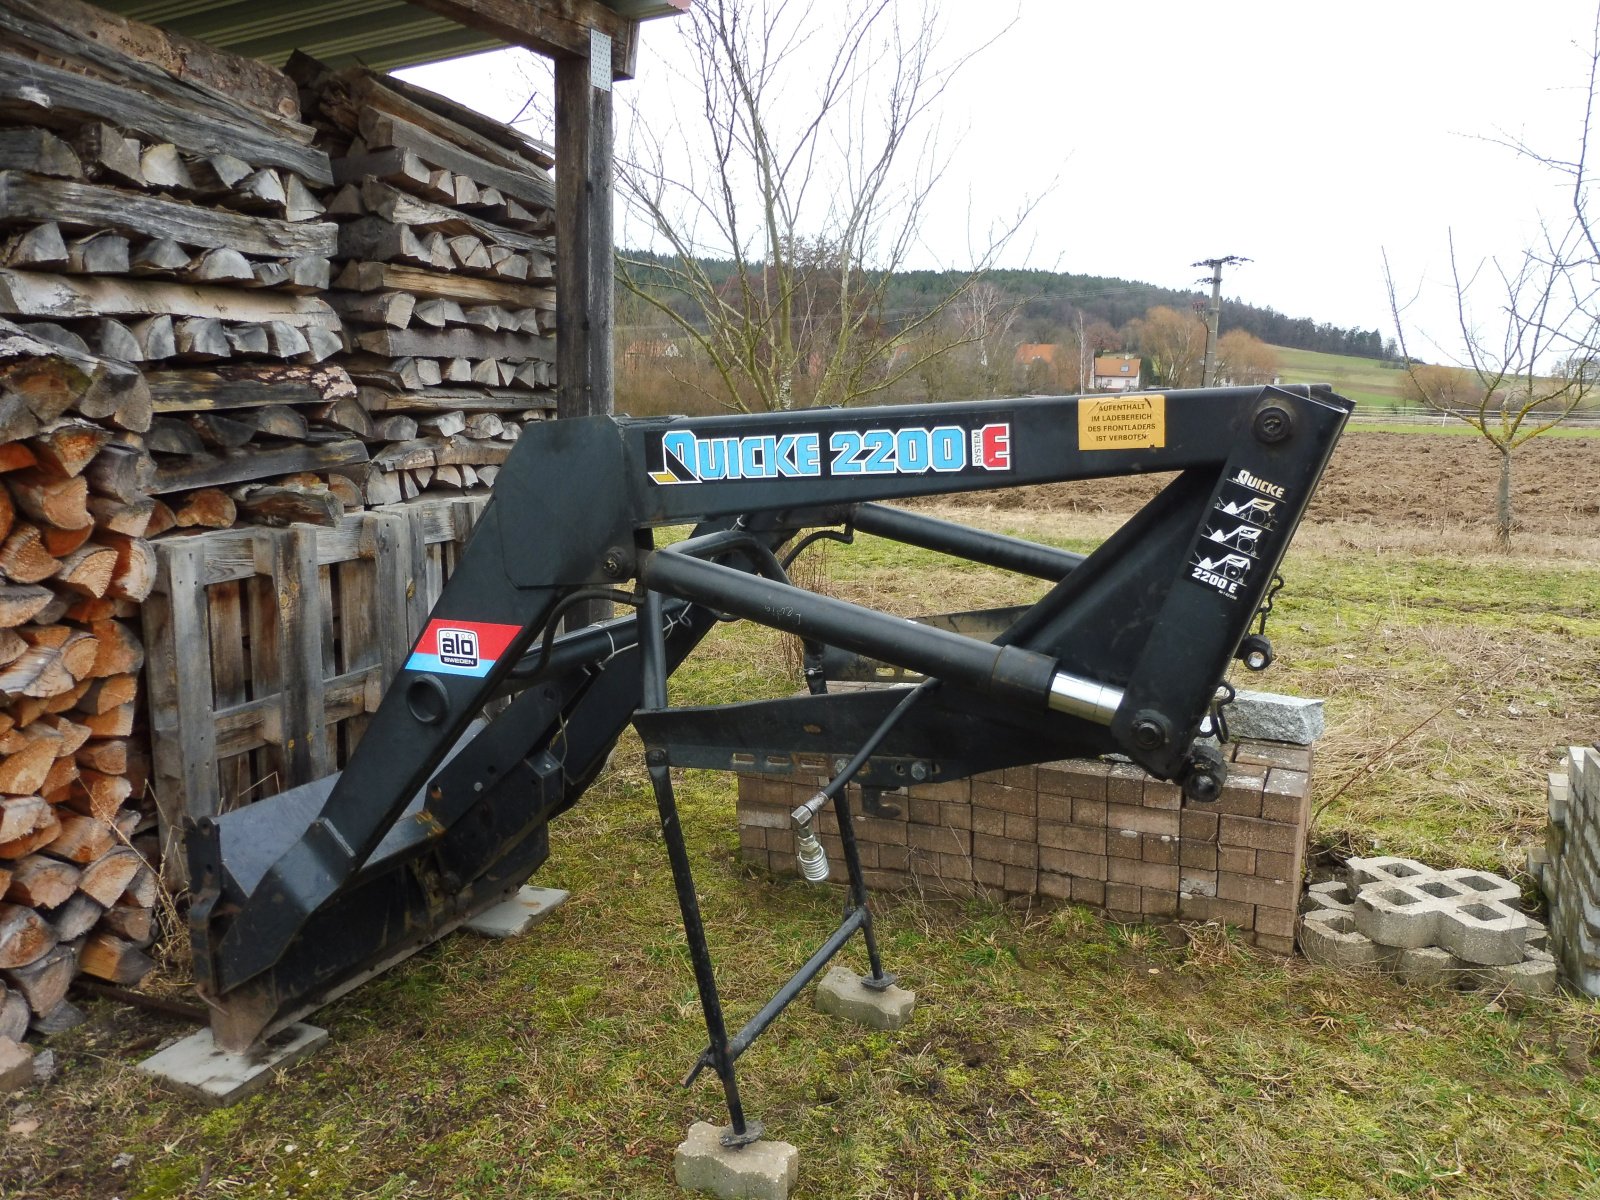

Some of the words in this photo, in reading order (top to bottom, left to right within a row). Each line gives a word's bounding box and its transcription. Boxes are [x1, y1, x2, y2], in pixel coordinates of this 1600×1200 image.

[1099, 403, 1146, 412] AUFENTHALT
[1102, 413, 1152, 422] LADEBEREICH
[1087, 425, 1101, 433] DES
[1103, 423, 1156, 432] FRONTLADERS
[1109, 433, 1147, 442] VERBOTEN
[648, 430, 821, 485] QUICKE
[830, 425, 966, 476] 2200
[973, 431, 982, 464] SYSTEM
[979, 423, 1010, 470] E
[1232, 469, 1285, 498] QUICKE
[1191, 568, 1227, 589] 2200
[1228, 582, 1238, 593] E
[443, 657, 474, 665] SWEDEN
